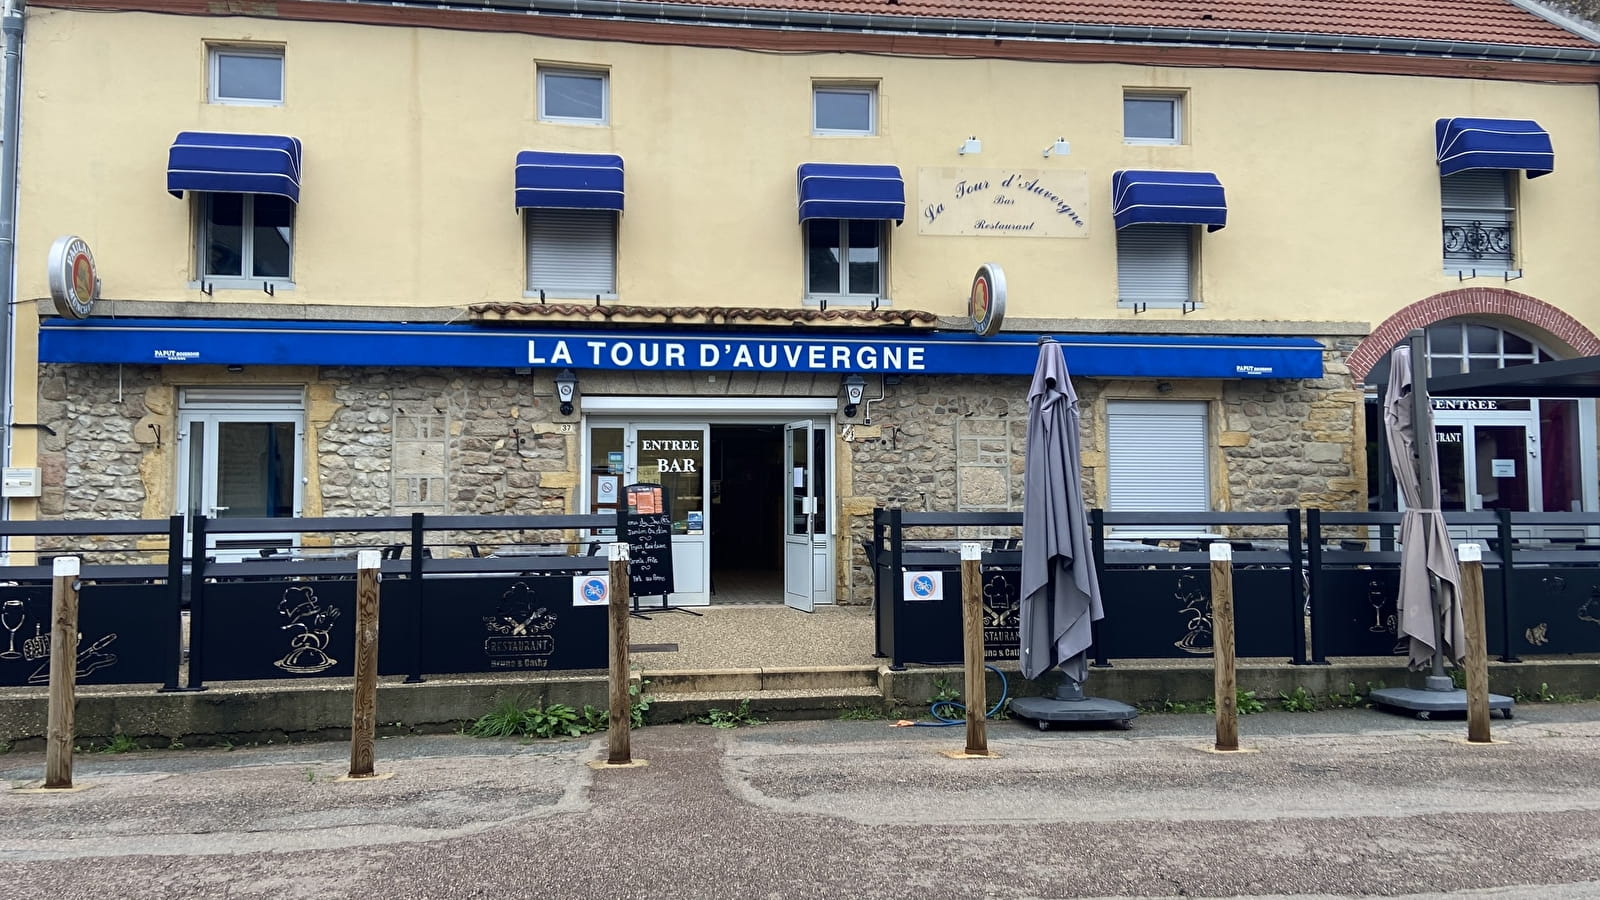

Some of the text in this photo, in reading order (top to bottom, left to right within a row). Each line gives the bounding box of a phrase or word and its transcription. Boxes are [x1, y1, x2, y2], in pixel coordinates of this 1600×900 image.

[924, 173, 1085, 228] La Tour d'Auvergne
[993, 194, 1015, 205] Bar
[974, 219, 1035, 231] Restaurant
[528, 340, 925, 370] LA TOUR D'AUVERGNE
[1435, 400, 1498, 409] ENTREE
[1435, 433, 1461, 442] URANT
[642, 440, 700, 451] ENTREE
[657, 458, 697, 473] BAR
[984, 631, 1020, 641] STAURAN
[491, 639, 548, 652] RESTAURANT
